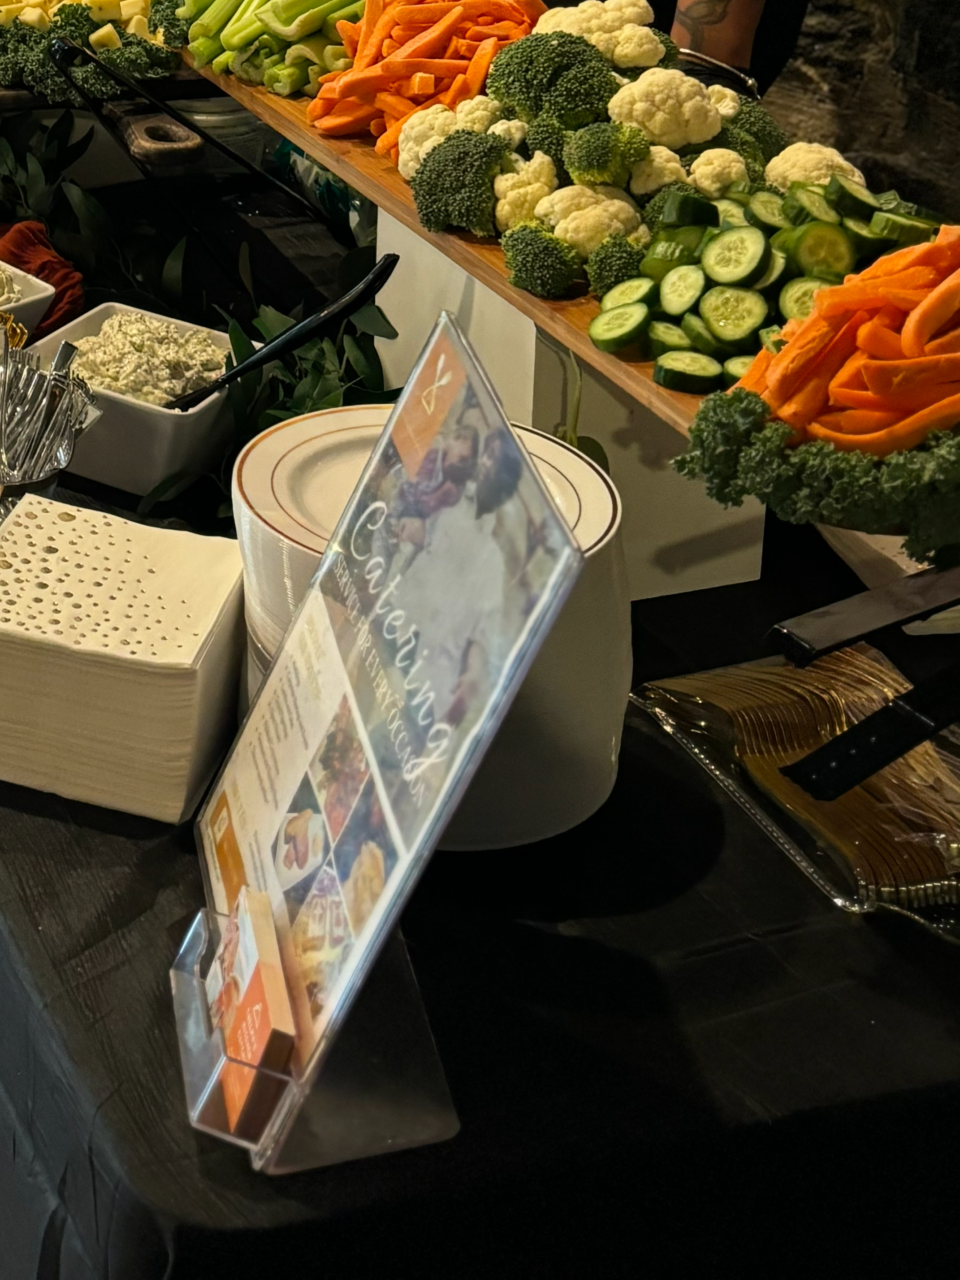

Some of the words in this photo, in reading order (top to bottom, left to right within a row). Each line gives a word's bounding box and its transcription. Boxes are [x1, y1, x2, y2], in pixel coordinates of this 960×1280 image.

[334, 553, 362, 624] SERVICE
[354, 614, 373, 658] FOR
[365, 647, 394, 711] EVERY
[350, 500, 452, 781] Catering
